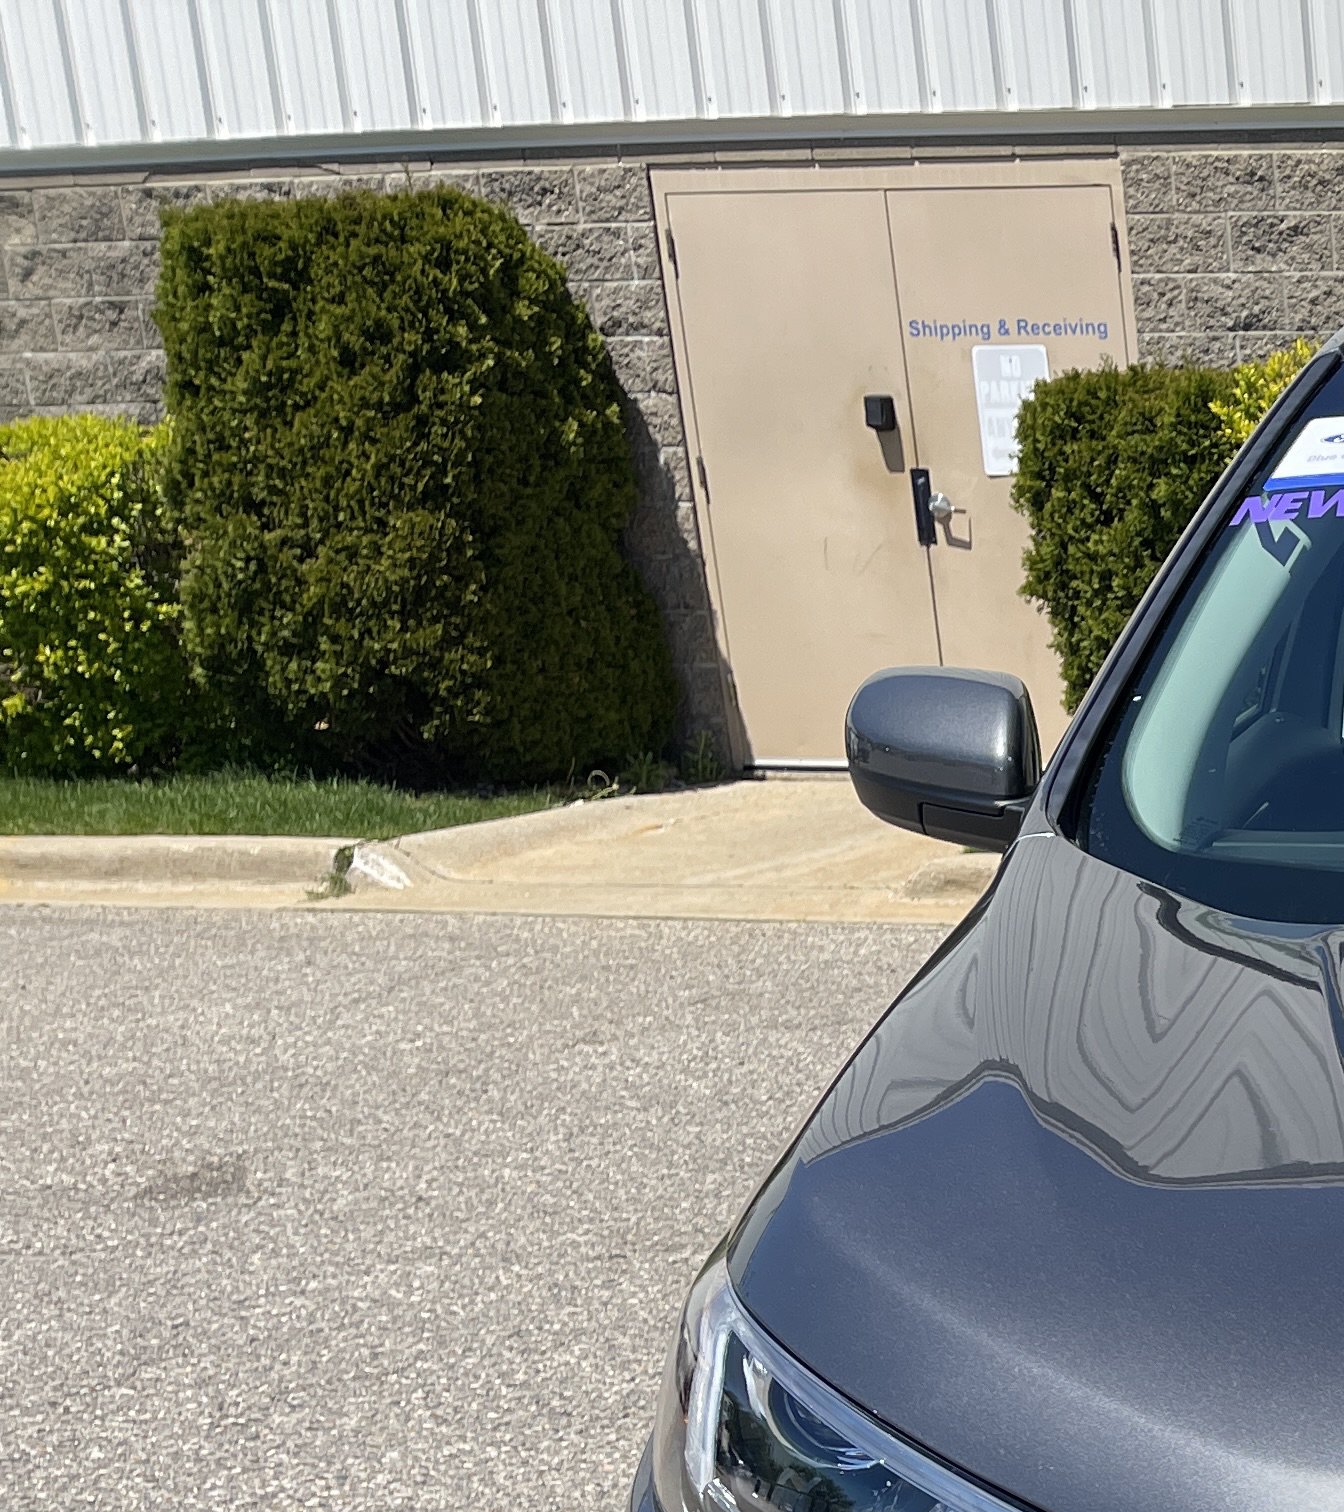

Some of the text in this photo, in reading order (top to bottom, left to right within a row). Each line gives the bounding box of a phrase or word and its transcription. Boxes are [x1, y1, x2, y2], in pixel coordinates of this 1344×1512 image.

[908, 318, 1109, 341] Shipping & Receiving
